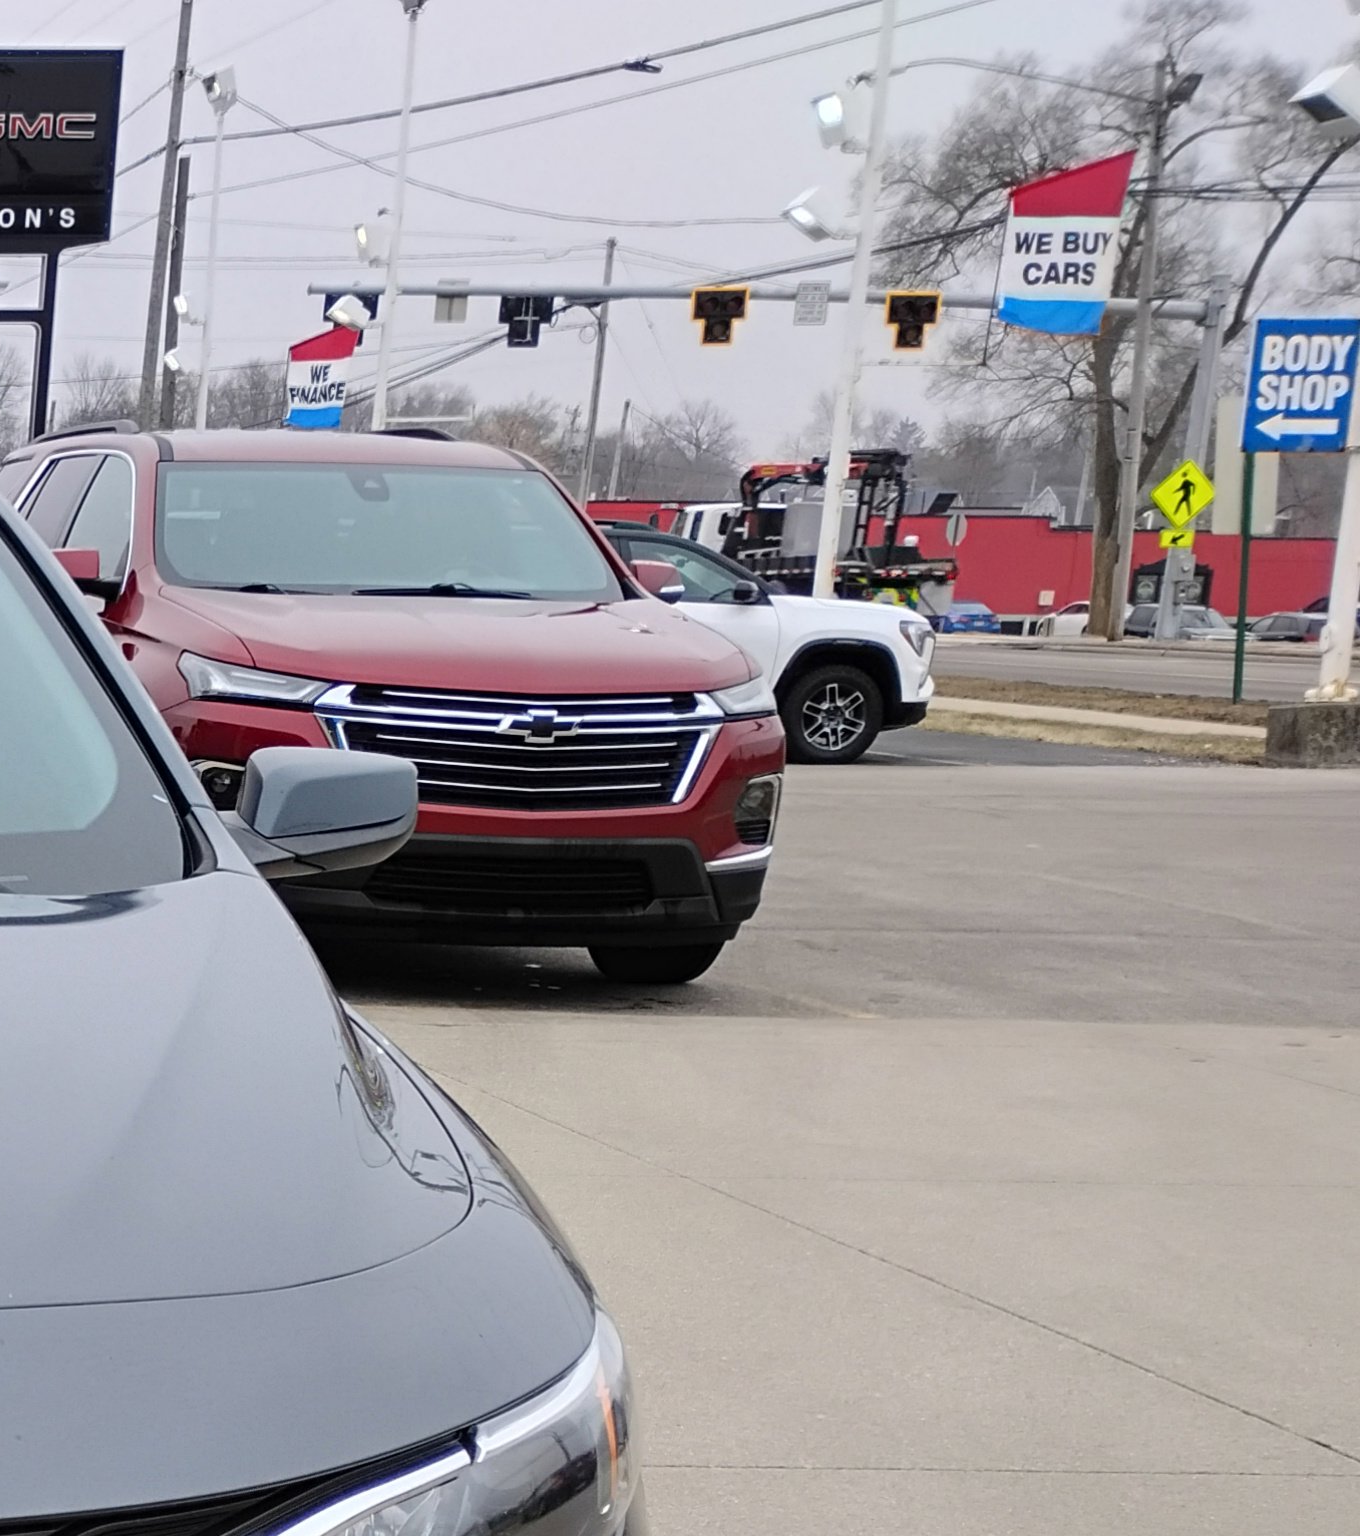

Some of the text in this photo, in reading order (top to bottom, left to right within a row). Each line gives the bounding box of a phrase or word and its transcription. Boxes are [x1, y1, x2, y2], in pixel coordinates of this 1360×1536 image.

[1015, 231, 1113, 256] WE BUY
[1022, 262, 1096, 286] CARS
[1260, 334, 1356, 372] BODY
[310, 364, 332, 384] WE
[288, 382, 346, 404] FINANCE
[1255, 374, 1350, 412] SHOP
